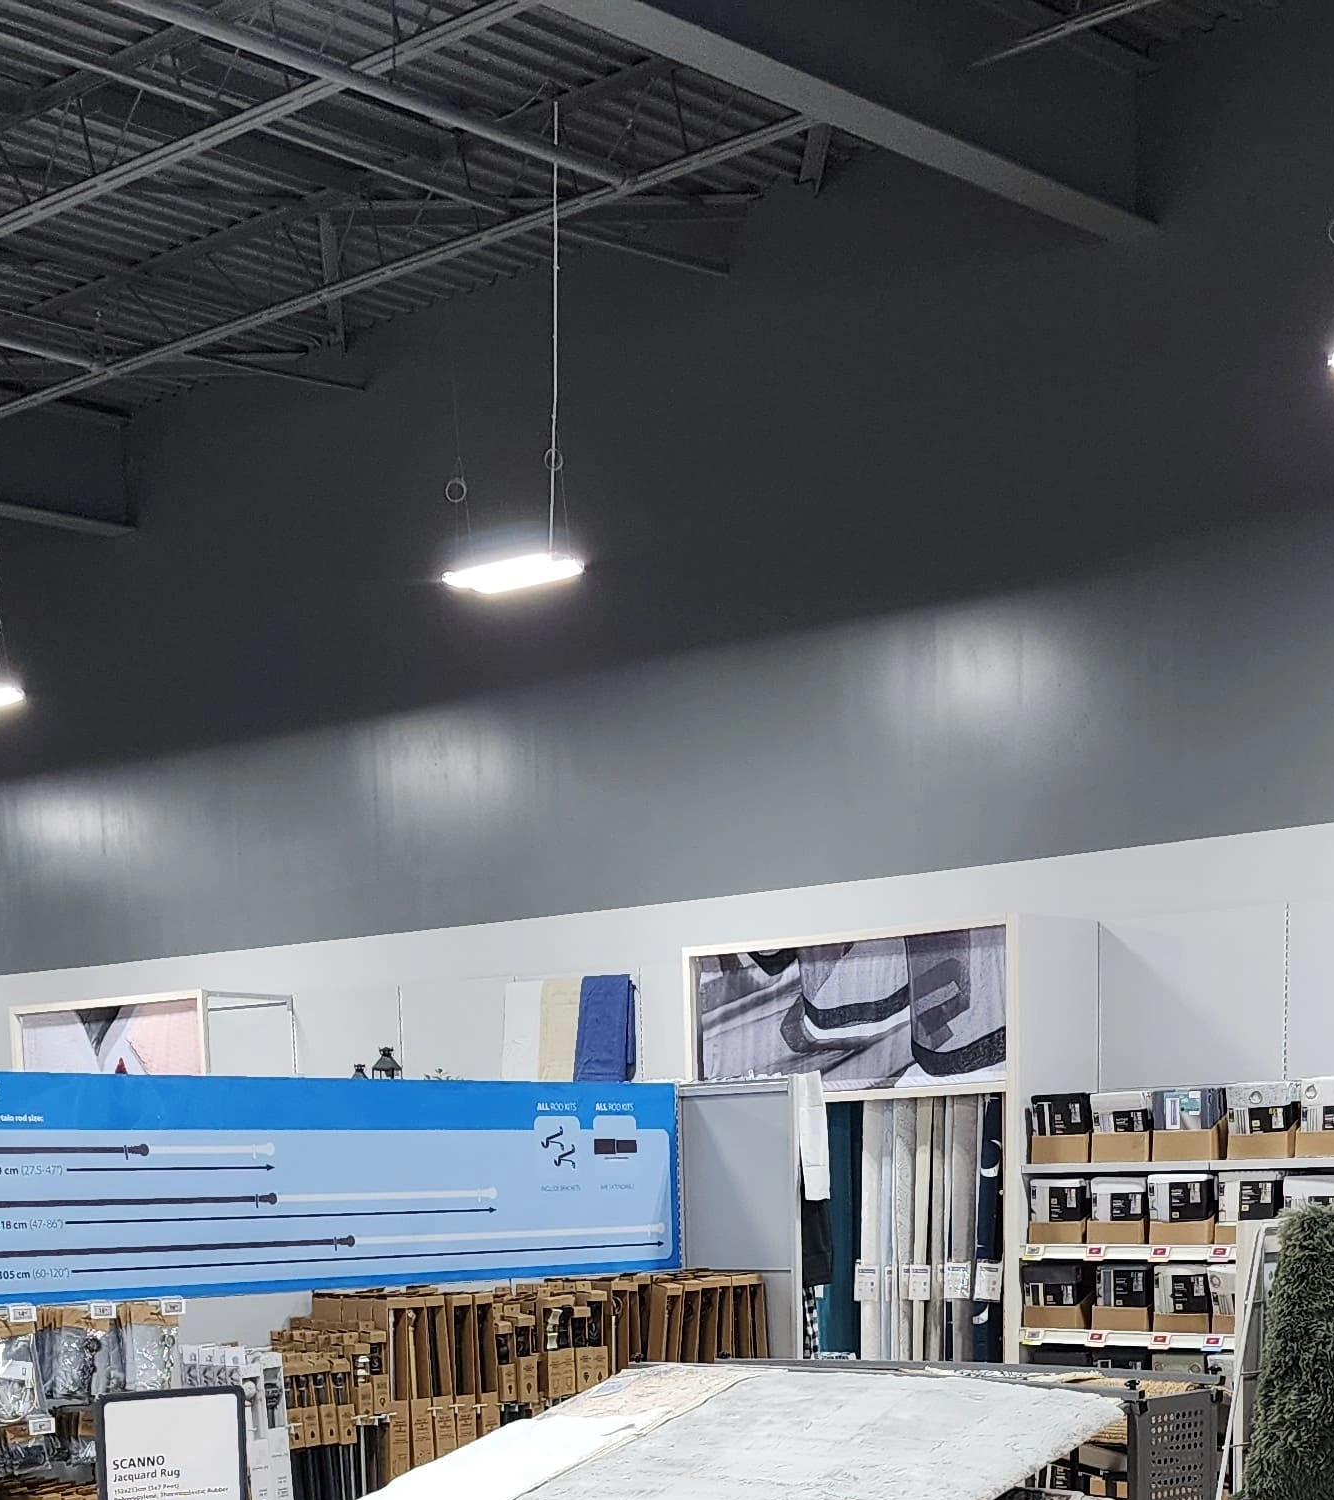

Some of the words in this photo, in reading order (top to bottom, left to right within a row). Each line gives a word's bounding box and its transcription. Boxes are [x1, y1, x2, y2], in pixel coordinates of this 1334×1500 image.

[536, 1102, 550, 1111] ALL
[595, 1102, 608, 1111] ALL
[15, 1113, 27, 1123] rod
[13, 1222, 28, 1230] cm
[16, 1272, 31, 1280] cm
[112, 1455, 165, 1471] SCANNO
[113, 1469, 157, 1483] Jacquard
[160, 1468, 181, 1479] Rug
